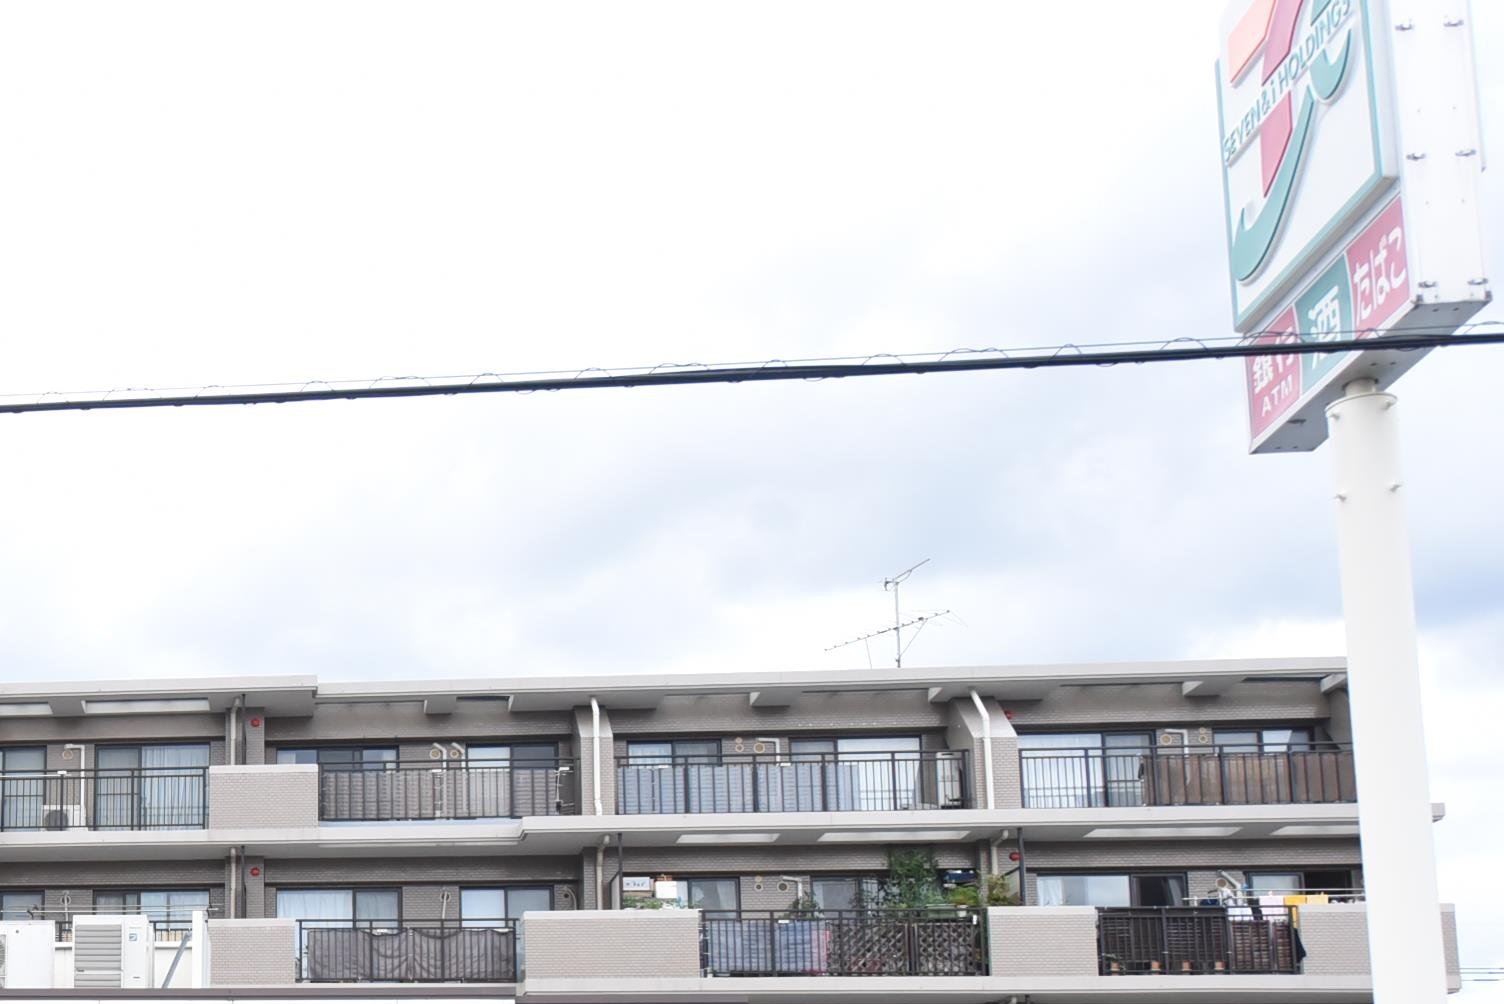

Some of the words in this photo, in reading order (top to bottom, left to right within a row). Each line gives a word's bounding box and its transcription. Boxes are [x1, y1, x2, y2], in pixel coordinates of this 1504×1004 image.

[1353, 226, 1406, 328] たばこ
[1252, 326, 1295, 394] 銀行
[1307, 285, 1342, 370] 酒
[1261, 374, 1294, 417] ATM
